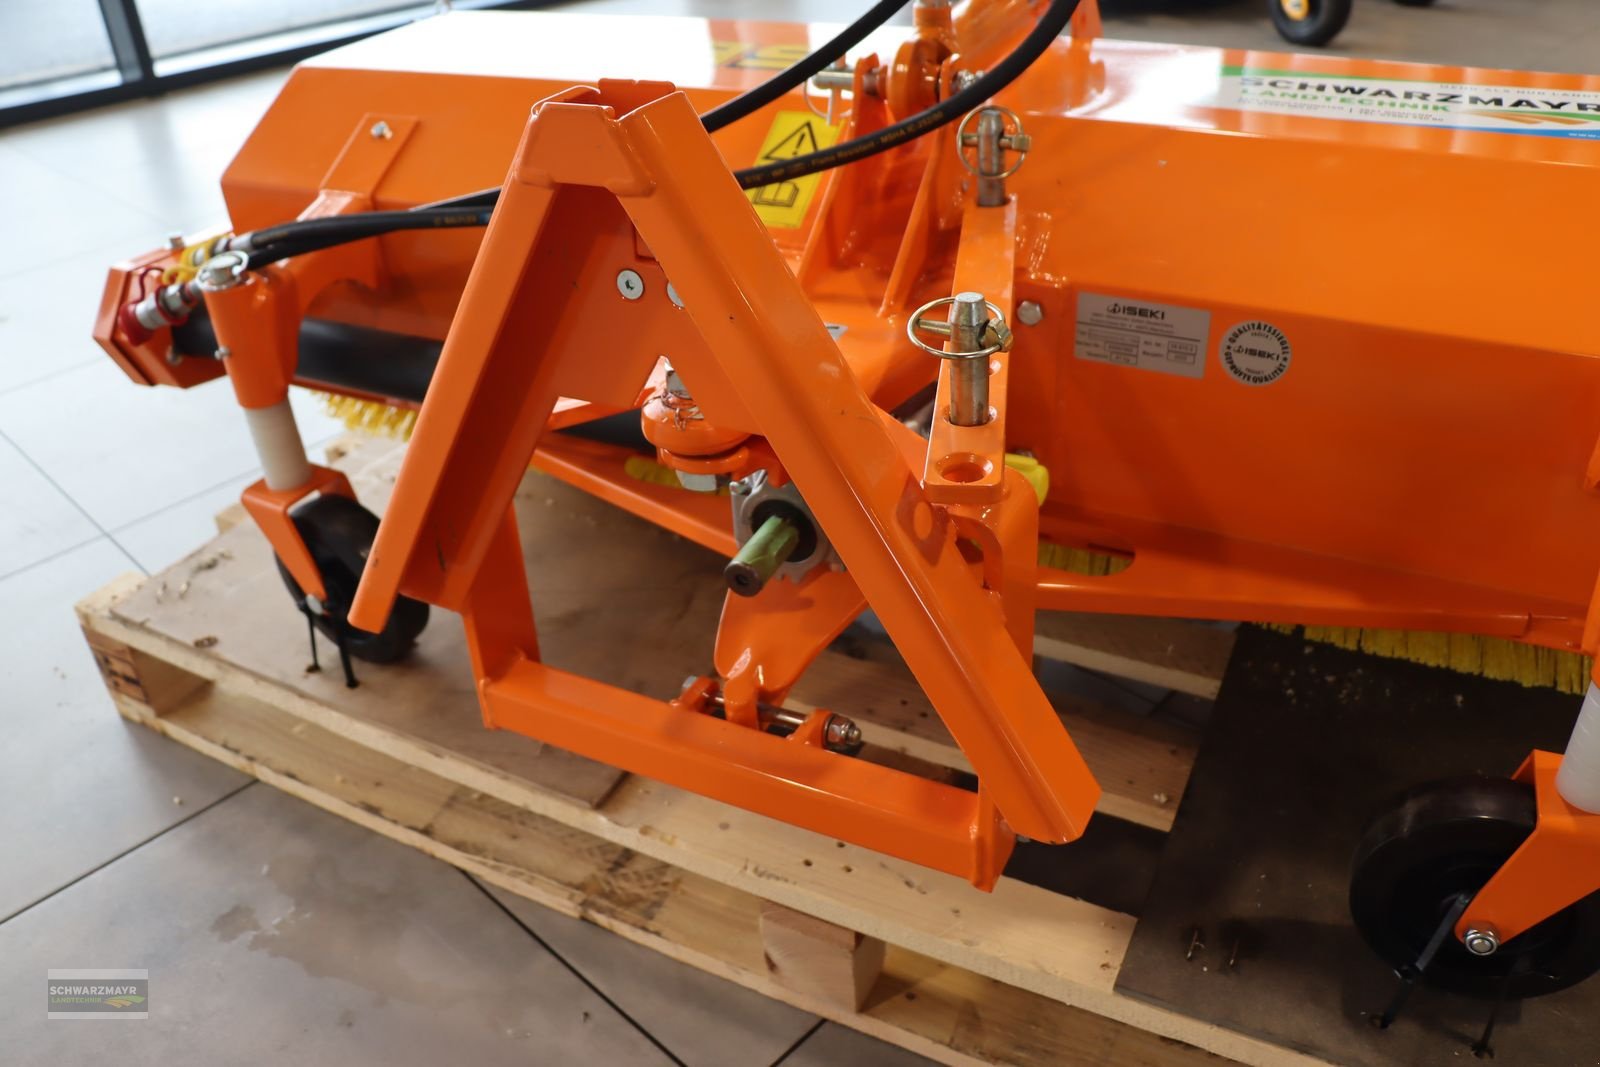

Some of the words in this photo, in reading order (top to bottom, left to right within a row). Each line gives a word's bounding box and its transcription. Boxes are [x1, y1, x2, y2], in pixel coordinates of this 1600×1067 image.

[1240, 77, 1600, 112] SCHWARZMAYR
[1240, 88, 1449, 112] LANDTECHNIK
[1122, 305, 1165, 321] ISEKI
[1244, 347, 1280, 361] ISEKI
